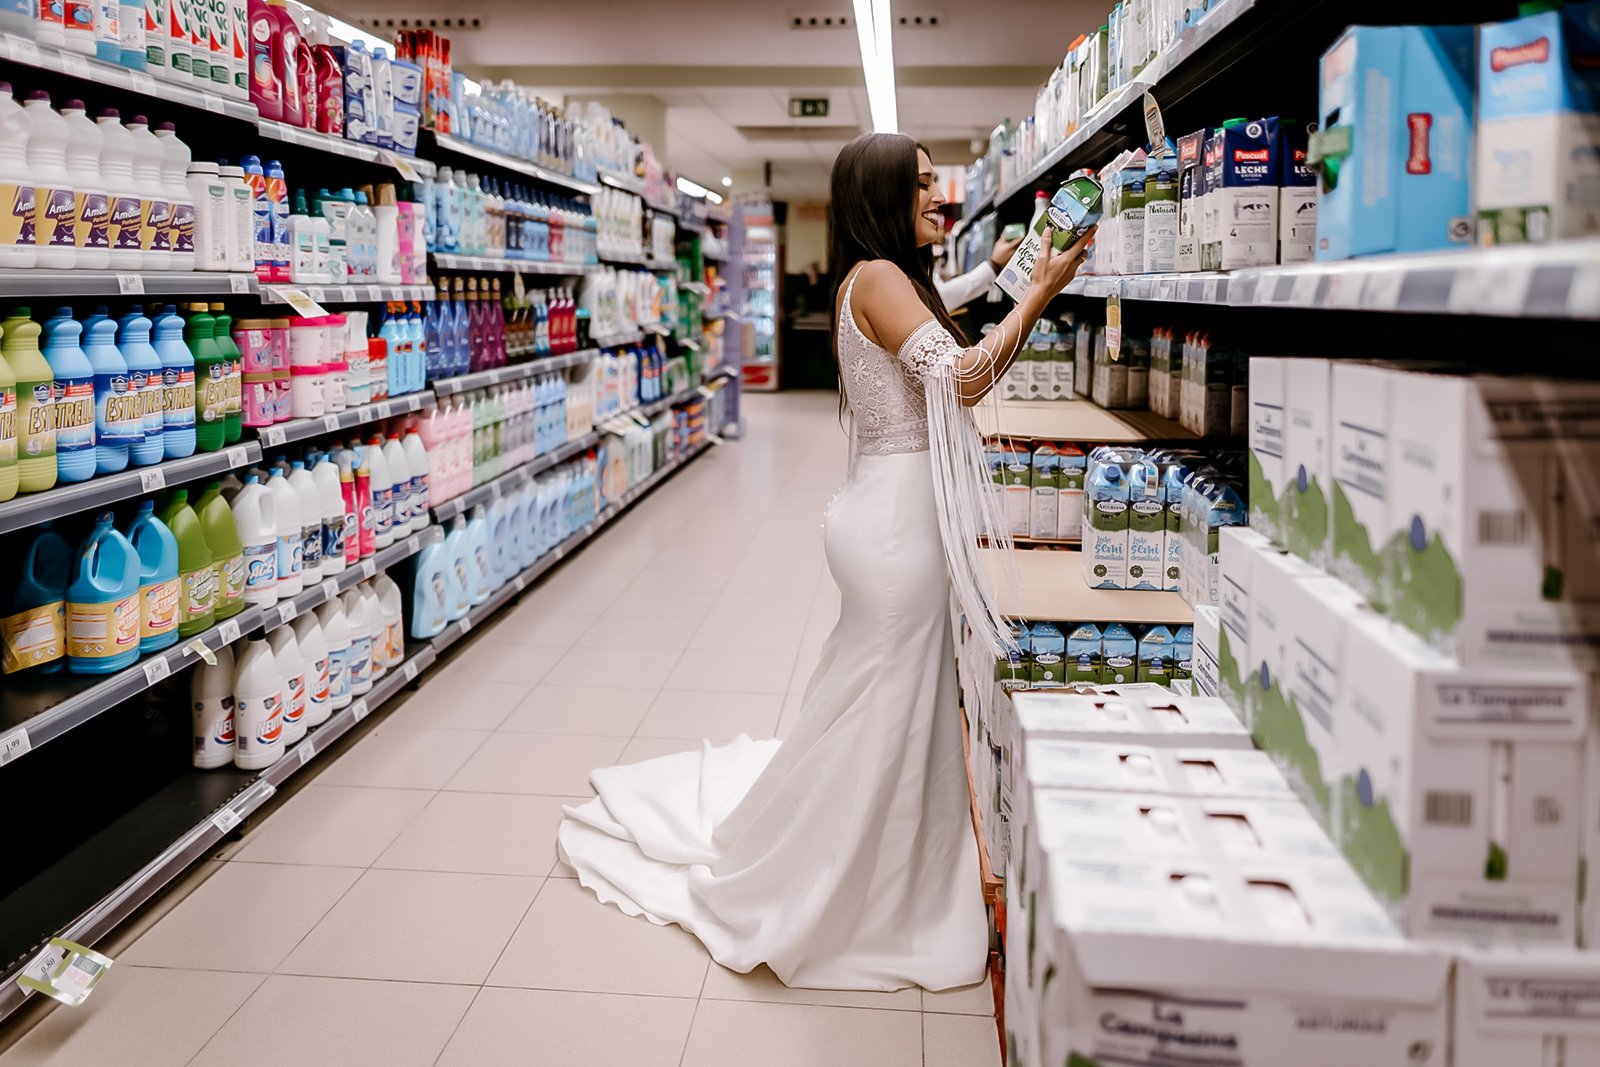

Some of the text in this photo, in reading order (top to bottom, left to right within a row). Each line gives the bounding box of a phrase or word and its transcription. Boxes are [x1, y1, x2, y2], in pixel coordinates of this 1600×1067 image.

[1235, 150, 1268, 160] Pascual
[1295, 151, 1306, 160] Pa
[1235, 166, 1268, 174] LECHE
[1149, 205, 1177, 214] Natural
[1230, 228, 1237, 237] 4
[1291, 228, 1296, 237] 1
[1133, 503, 1161, 511] ASTURIANA
[40, 957, 56, 975] 0.80
[1153, 1000, 1184, 1025] La
